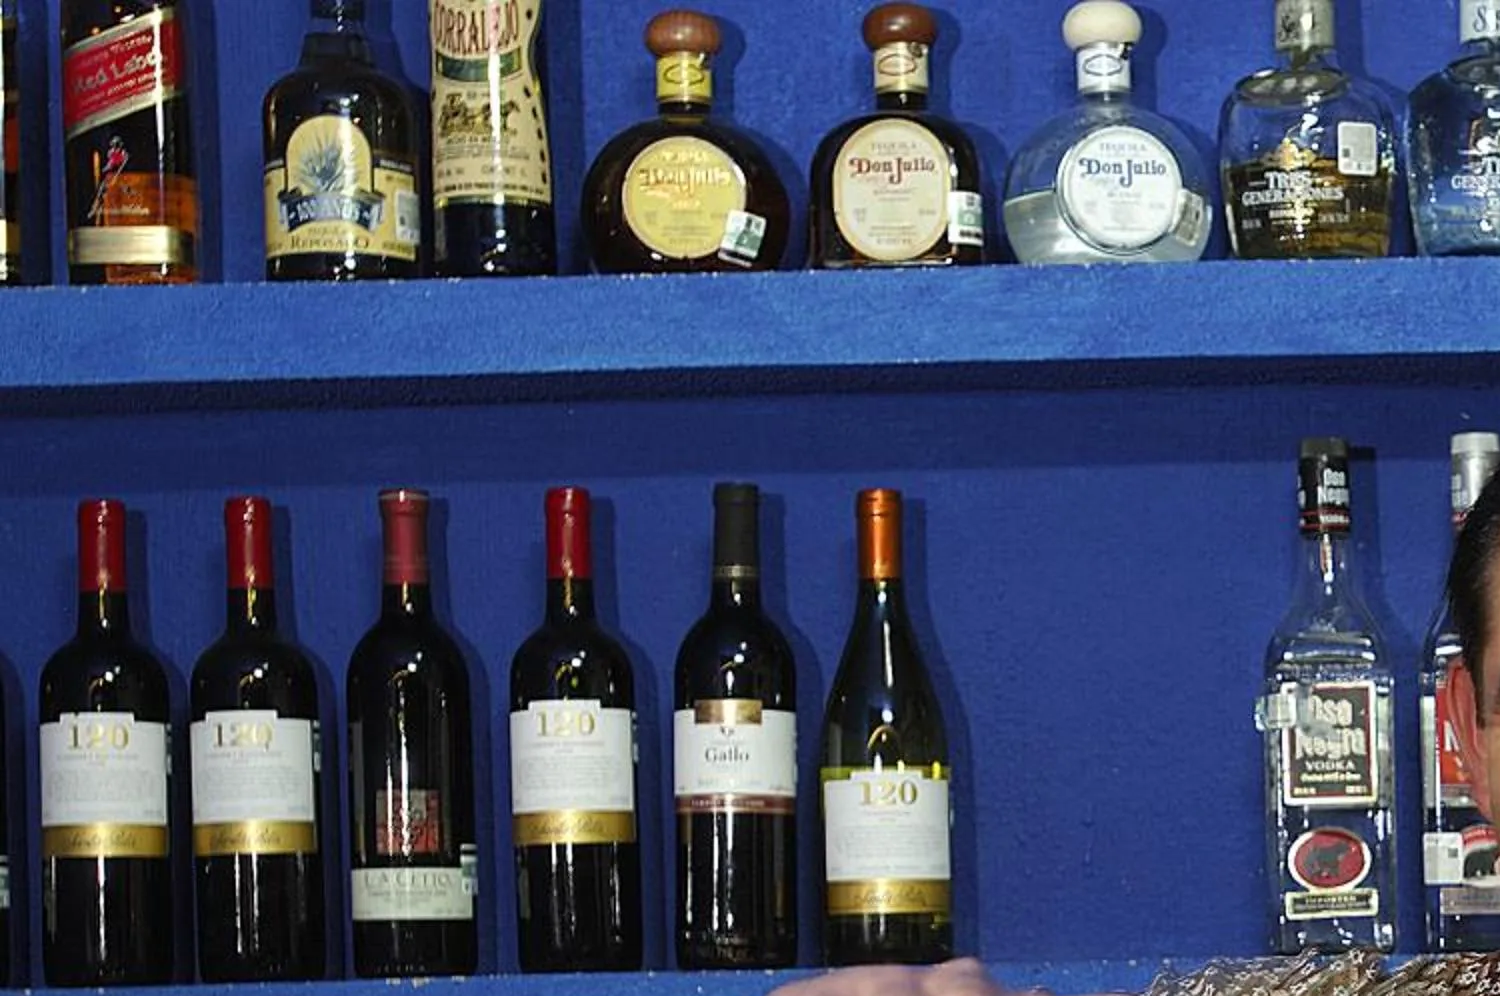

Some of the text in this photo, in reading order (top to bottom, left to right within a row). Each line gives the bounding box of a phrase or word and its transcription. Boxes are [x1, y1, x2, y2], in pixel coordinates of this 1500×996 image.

[849, 156, 935, 185] Don Julio
[1079, 157, 1167, 188] Don Julio
[1264, 171, 1312, 190] TRES
[70, 723, 128, 751] 120
[213, 722, 273, 749] 120
[538, 710, 595, 737] 120
[705, 746, 750, 763] Gallo
[860, 780, 918, 806] 120
